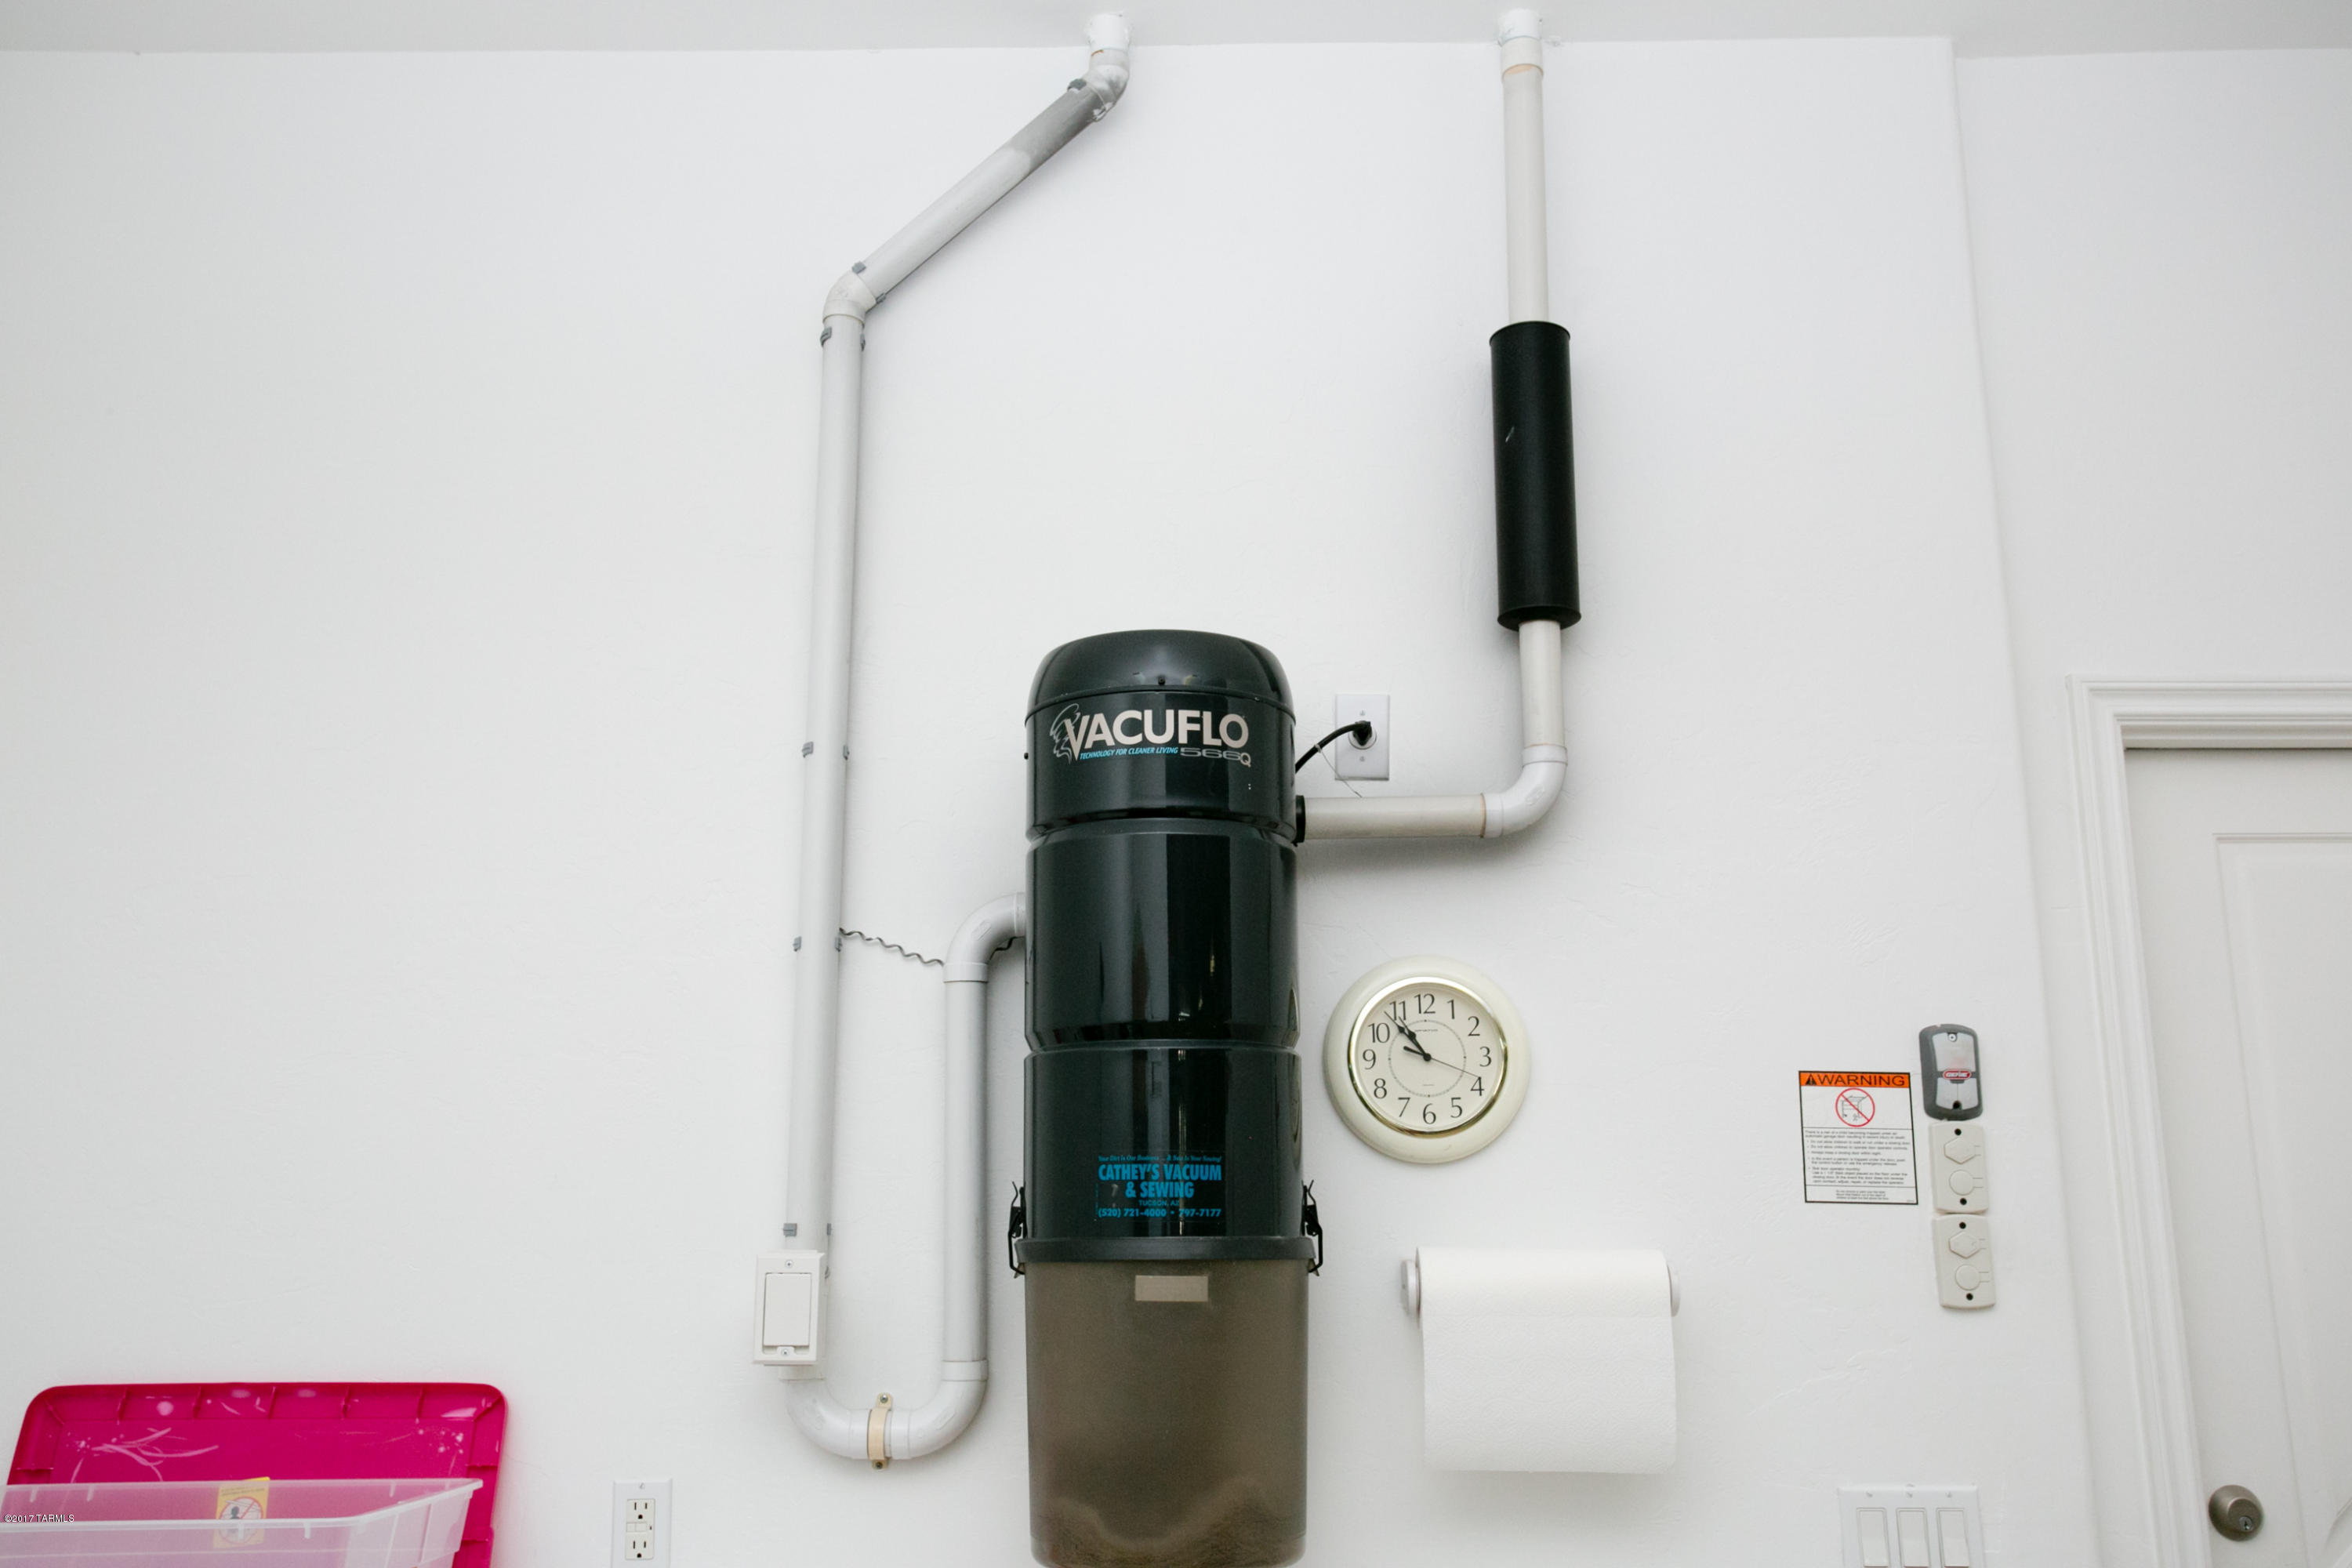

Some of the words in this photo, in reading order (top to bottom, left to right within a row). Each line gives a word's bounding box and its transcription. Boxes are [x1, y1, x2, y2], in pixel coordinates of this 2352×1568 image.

[1065, 709, 1249, 761] VACUFLO
[1080, 749, 1115, 760] TECHNOLOGY
[1389, 1000, 1406, 1021] 11
[1414, 993, 1436, 1014] 12
[1446, 999, 1455, 1020] 1
[1368, 1022, 1391, 1044] 10
[1468, 1016, 1481, 1036] 2
[1363, 1048, 1377, 1070] 9
[1479, 1046, 1492, 1067] 3
[1374, 1078, 1388, 1099] 8
[1470, 1076, 1485, 1097] 4
[1817, 1074, 1905, 1087] WARNING
[1397, 1097, 1410, 1117] 7
[1422, 1103, 1437, 1124] 6
[1450, 1097, 1463, 1118] 5
[1098, 1163, 1160, 1181] CATHEY'S
[1163, 1163, 1222, 1181] VACUUM
[1124, 1181, 1136, 1198] &
[1140, 1181, 1195, 1198] SEWING
[1098, 1208, 1121, 1218] (520)
[1123, 1208, 1167, 1217] 721-4000
[1178, 1208, 1222, 1217] 797-7177
